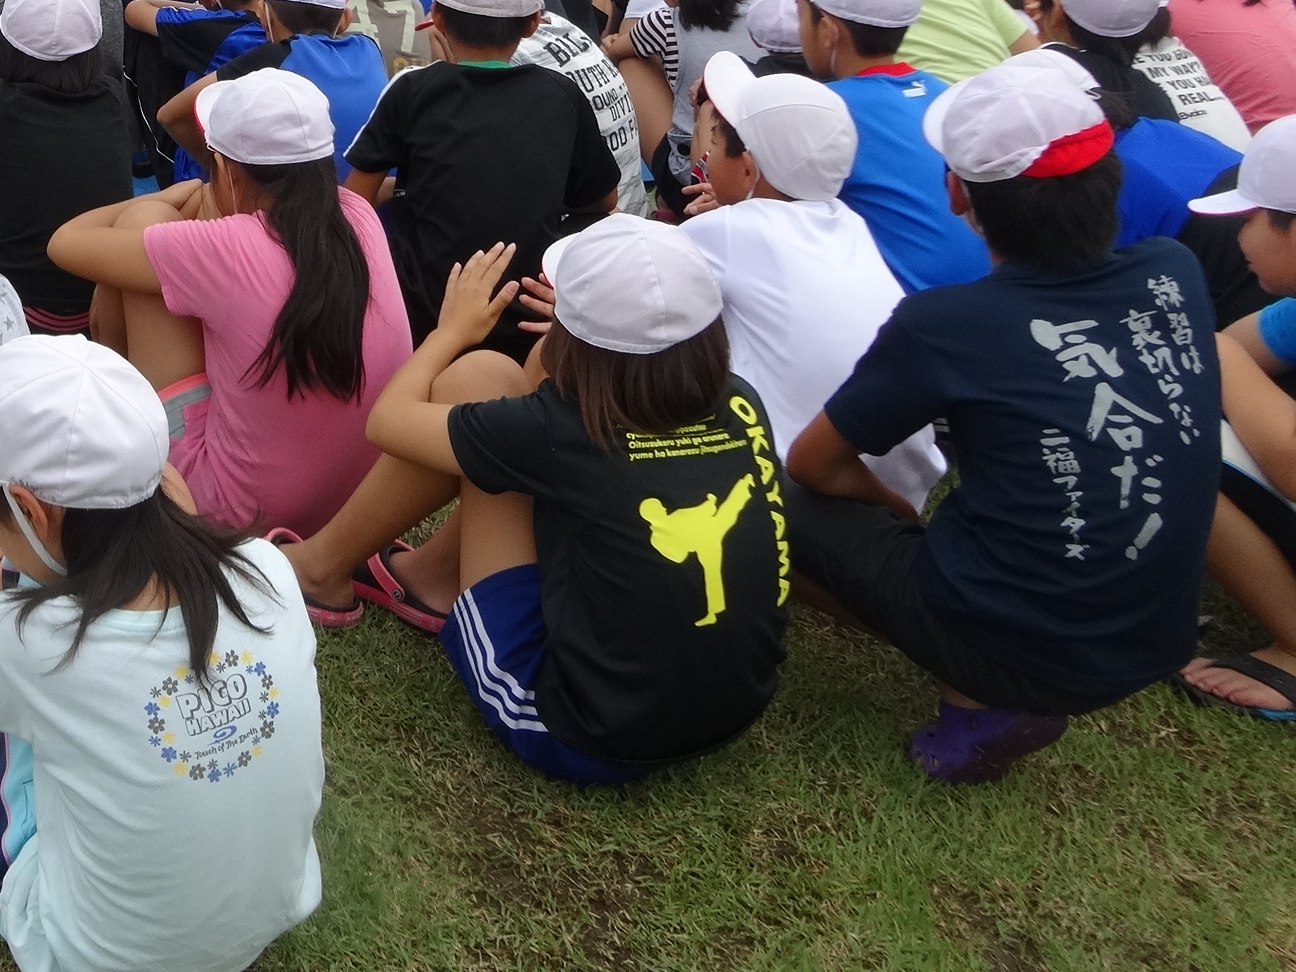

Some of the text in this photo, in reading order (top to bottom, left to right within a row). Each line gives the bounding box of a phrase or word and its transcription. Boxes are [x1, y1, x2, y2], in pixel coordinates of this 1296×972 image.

[1147, 61, 1203, 79] MY WAY?
[1166, 78, 1196, 91] YOU
[1147, 275, 1203, 374] 練習は
[1119, 309, 1200, 445] 裏切らない
[629, 452, 654, 461] yume
[654, 449, 666, 458] ha
[675, 437, 692, 447] yuki
[692, 436, 702, 445] ga
[729, 395, 790, 607] OKAYAMA
[1040, 428, 1090, 561] 二福ファイターズ
[175, 673, 247, 720] PICO
[184, 698, 252, 737] HAWAII
[194, 727, 258, 760] Touch of The Earth
